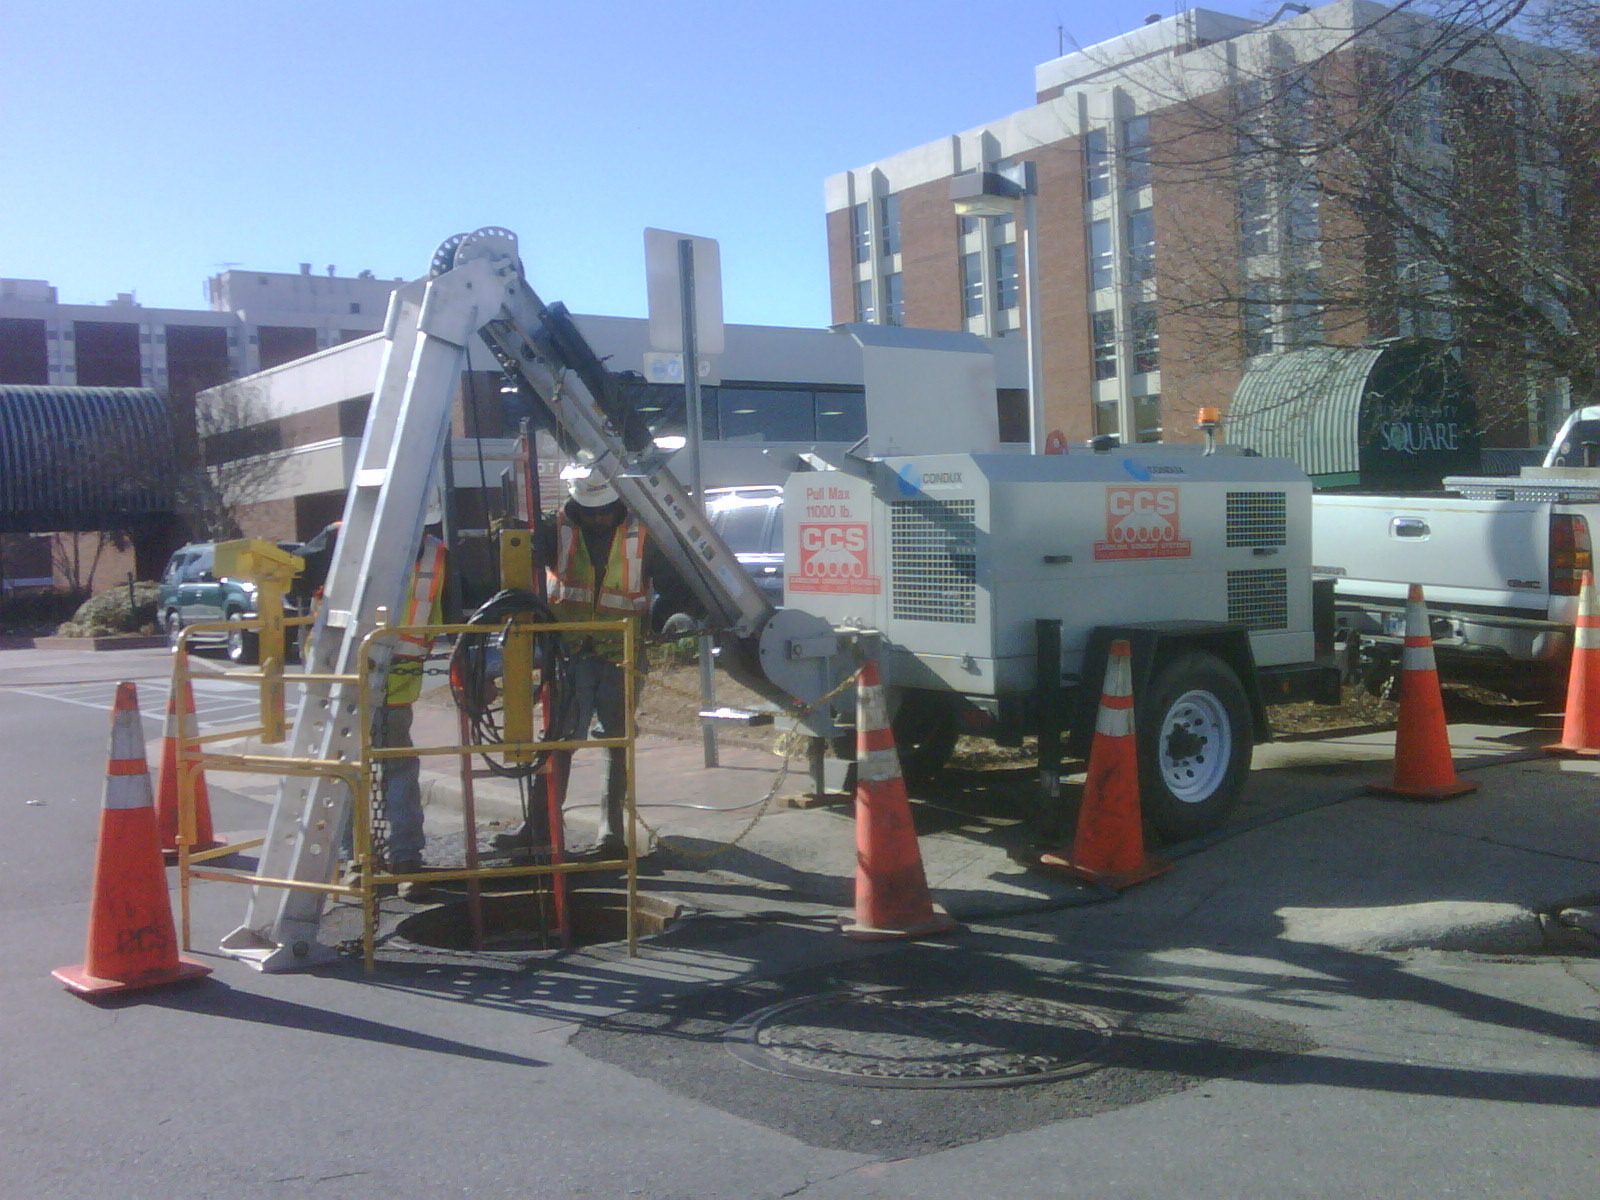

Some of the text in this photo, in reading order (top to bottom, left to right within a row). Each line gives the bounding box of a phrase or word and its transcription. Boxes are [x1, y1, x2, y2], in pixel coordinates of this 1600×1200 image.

[1380, 422, 1459, 455] SQUARE
[922, 472, 963, 485] CONDUX
[806, 487, 850, 501] Pull Max
[1110, 491, 1176, 515] CCS
[806, 505, 836, 518] 11000
[803, 527, 865, 551] CCS
